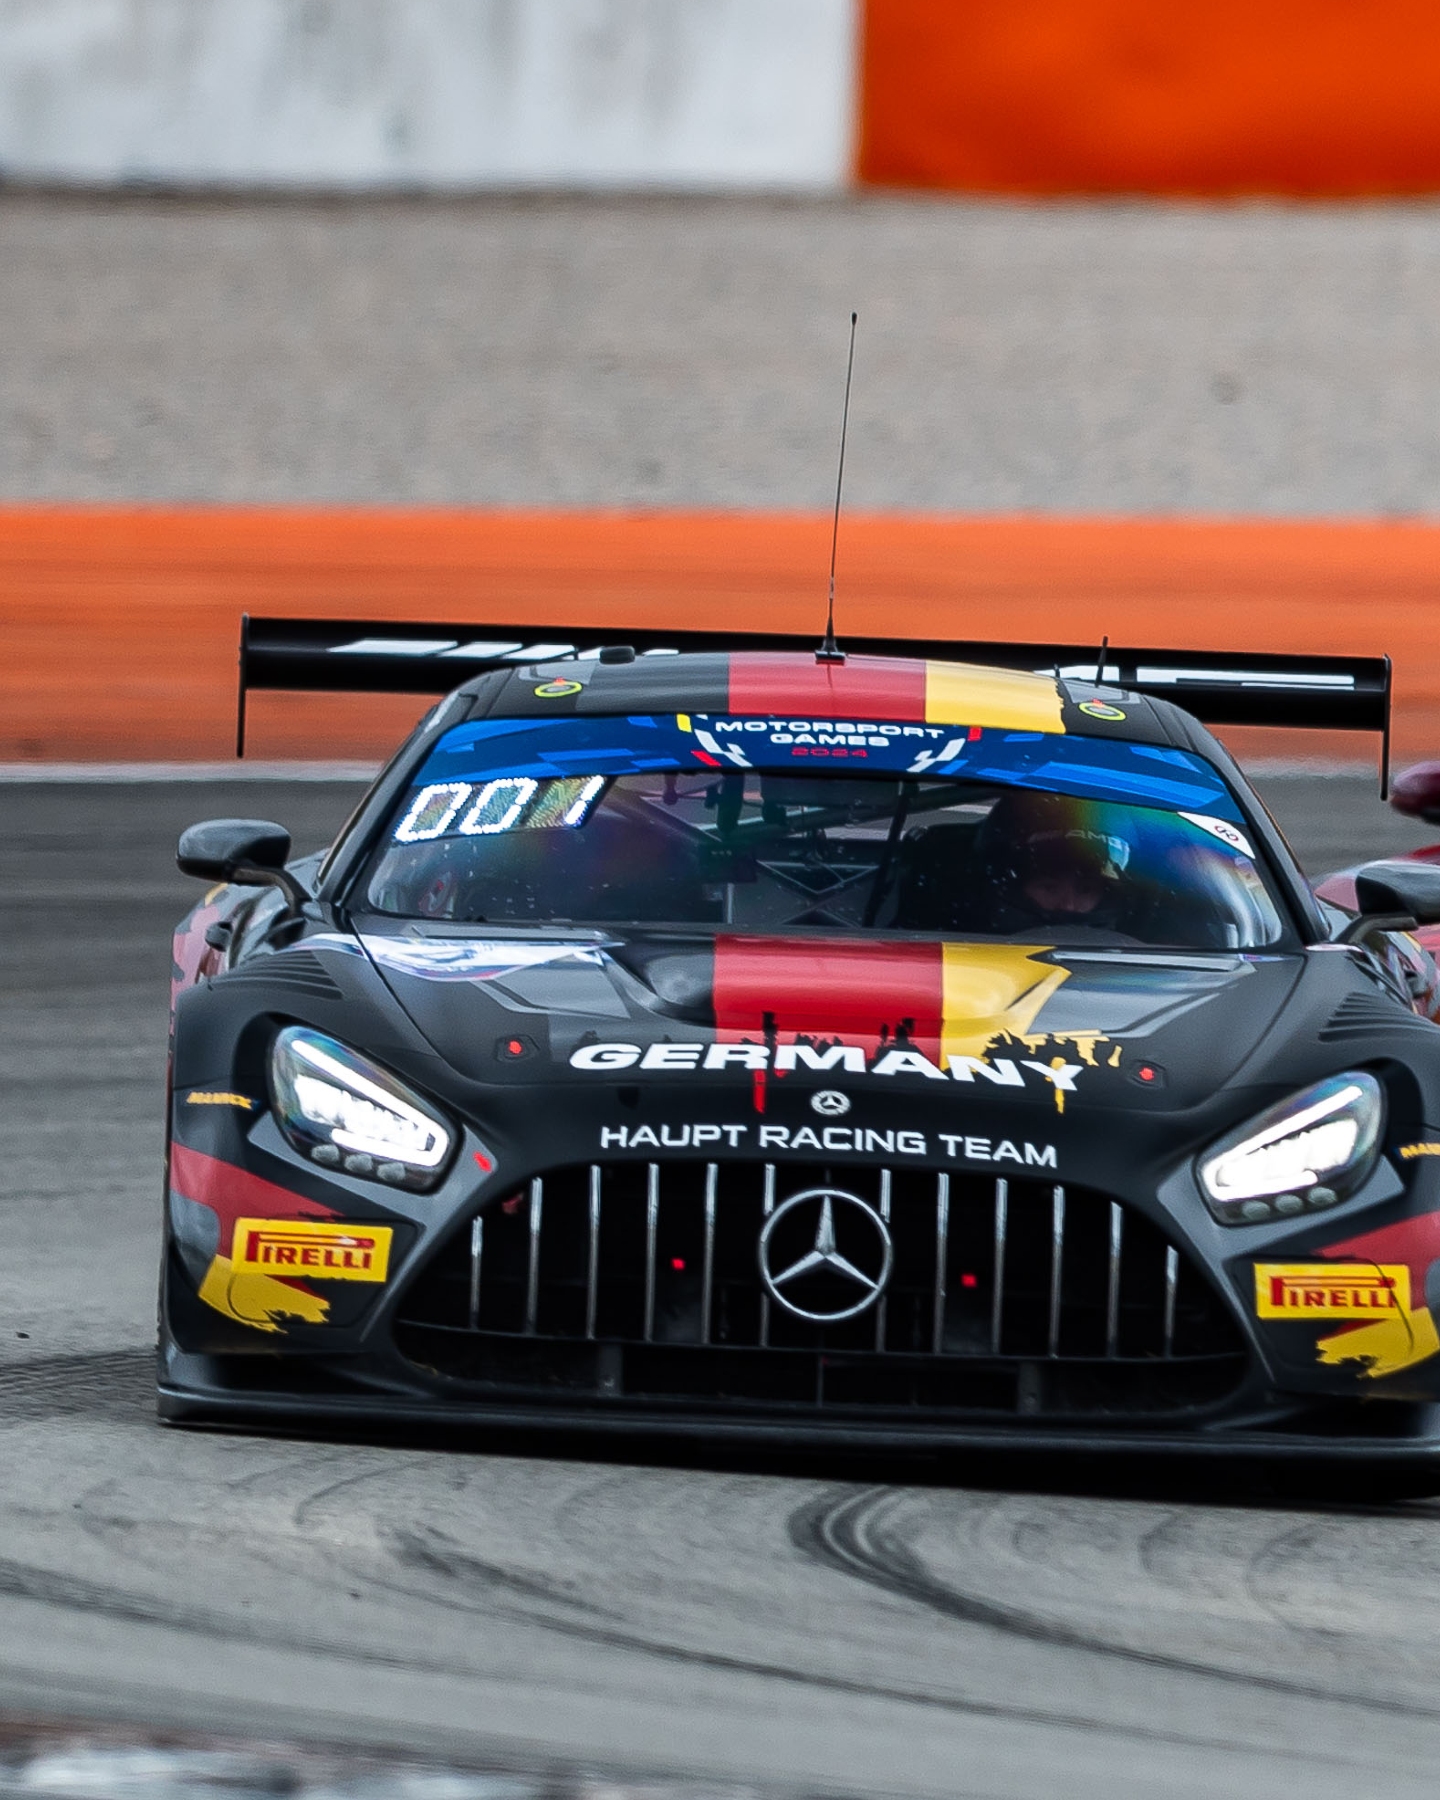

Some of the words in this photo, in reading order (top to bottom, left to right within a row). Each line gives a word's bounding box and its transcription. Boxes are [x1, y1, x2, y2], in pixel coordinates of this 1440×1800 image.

[715, 720, 945, 739] MOTORSPORT
[770, 732, 890, 747] GAMES
[791, 747, 868, 758] 2024
[395, 774, 605, 842] 001
[569, 1042, 1085, 1091] GERMANY
[600, 1123, 747, 1150] HAUPT
[758, 1125, 927, 1155] RACING
[938, 1133, 1058, 1169] TEAM
[245, 1230, 376, 1270] PIRELLI
[1270, 1275, 1399, 1308] PIRELLI
